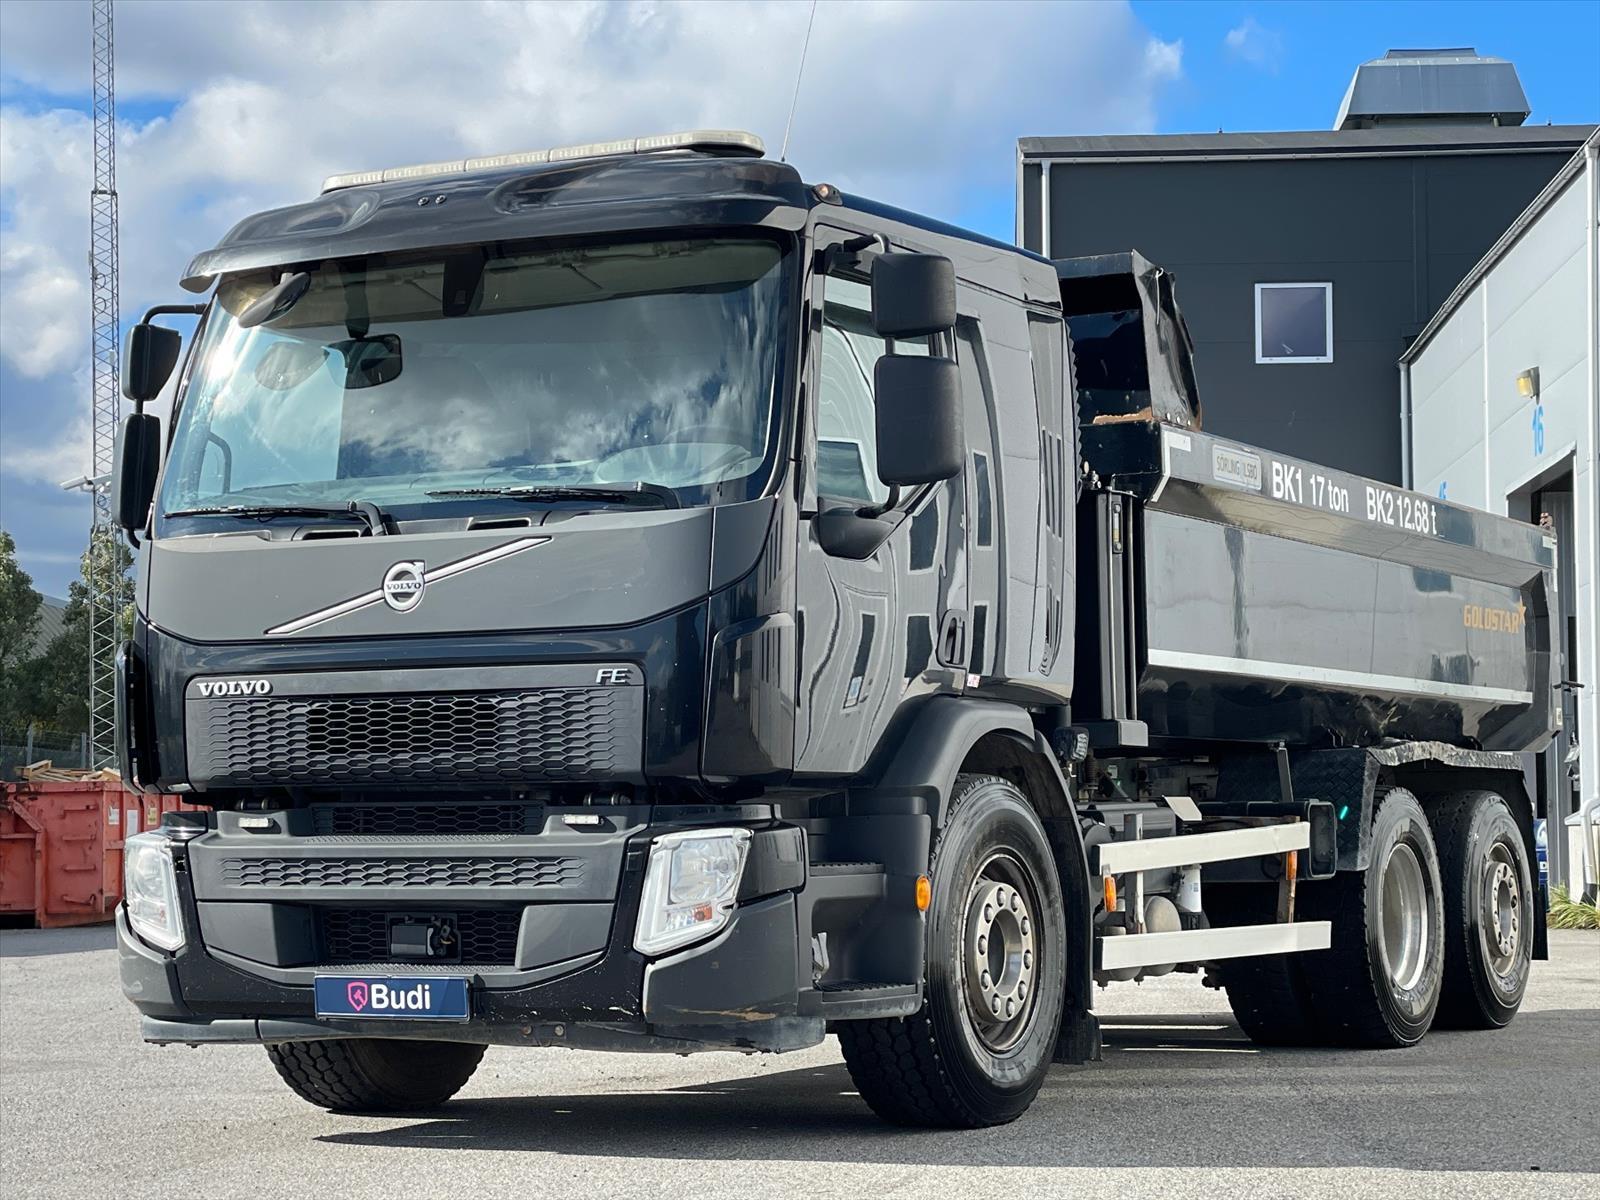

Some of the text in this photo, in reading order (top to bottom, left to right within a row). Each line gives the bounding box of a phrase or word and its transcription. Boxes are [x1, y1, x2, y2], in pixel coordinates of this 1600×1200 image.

[1532, 405, 1544, 457] 16
[1271, 461, 1437, 535] BK1 17 ton BK2 12.68 t
[386, 582, 422, 590] VOLVO
[1463, 604, 1520, 634] GOLDSTAR
[196, 679, 271, 696] VOLVO
[595, 668, 630, 683] FE
[370, 983, 431, 1010] Budi
